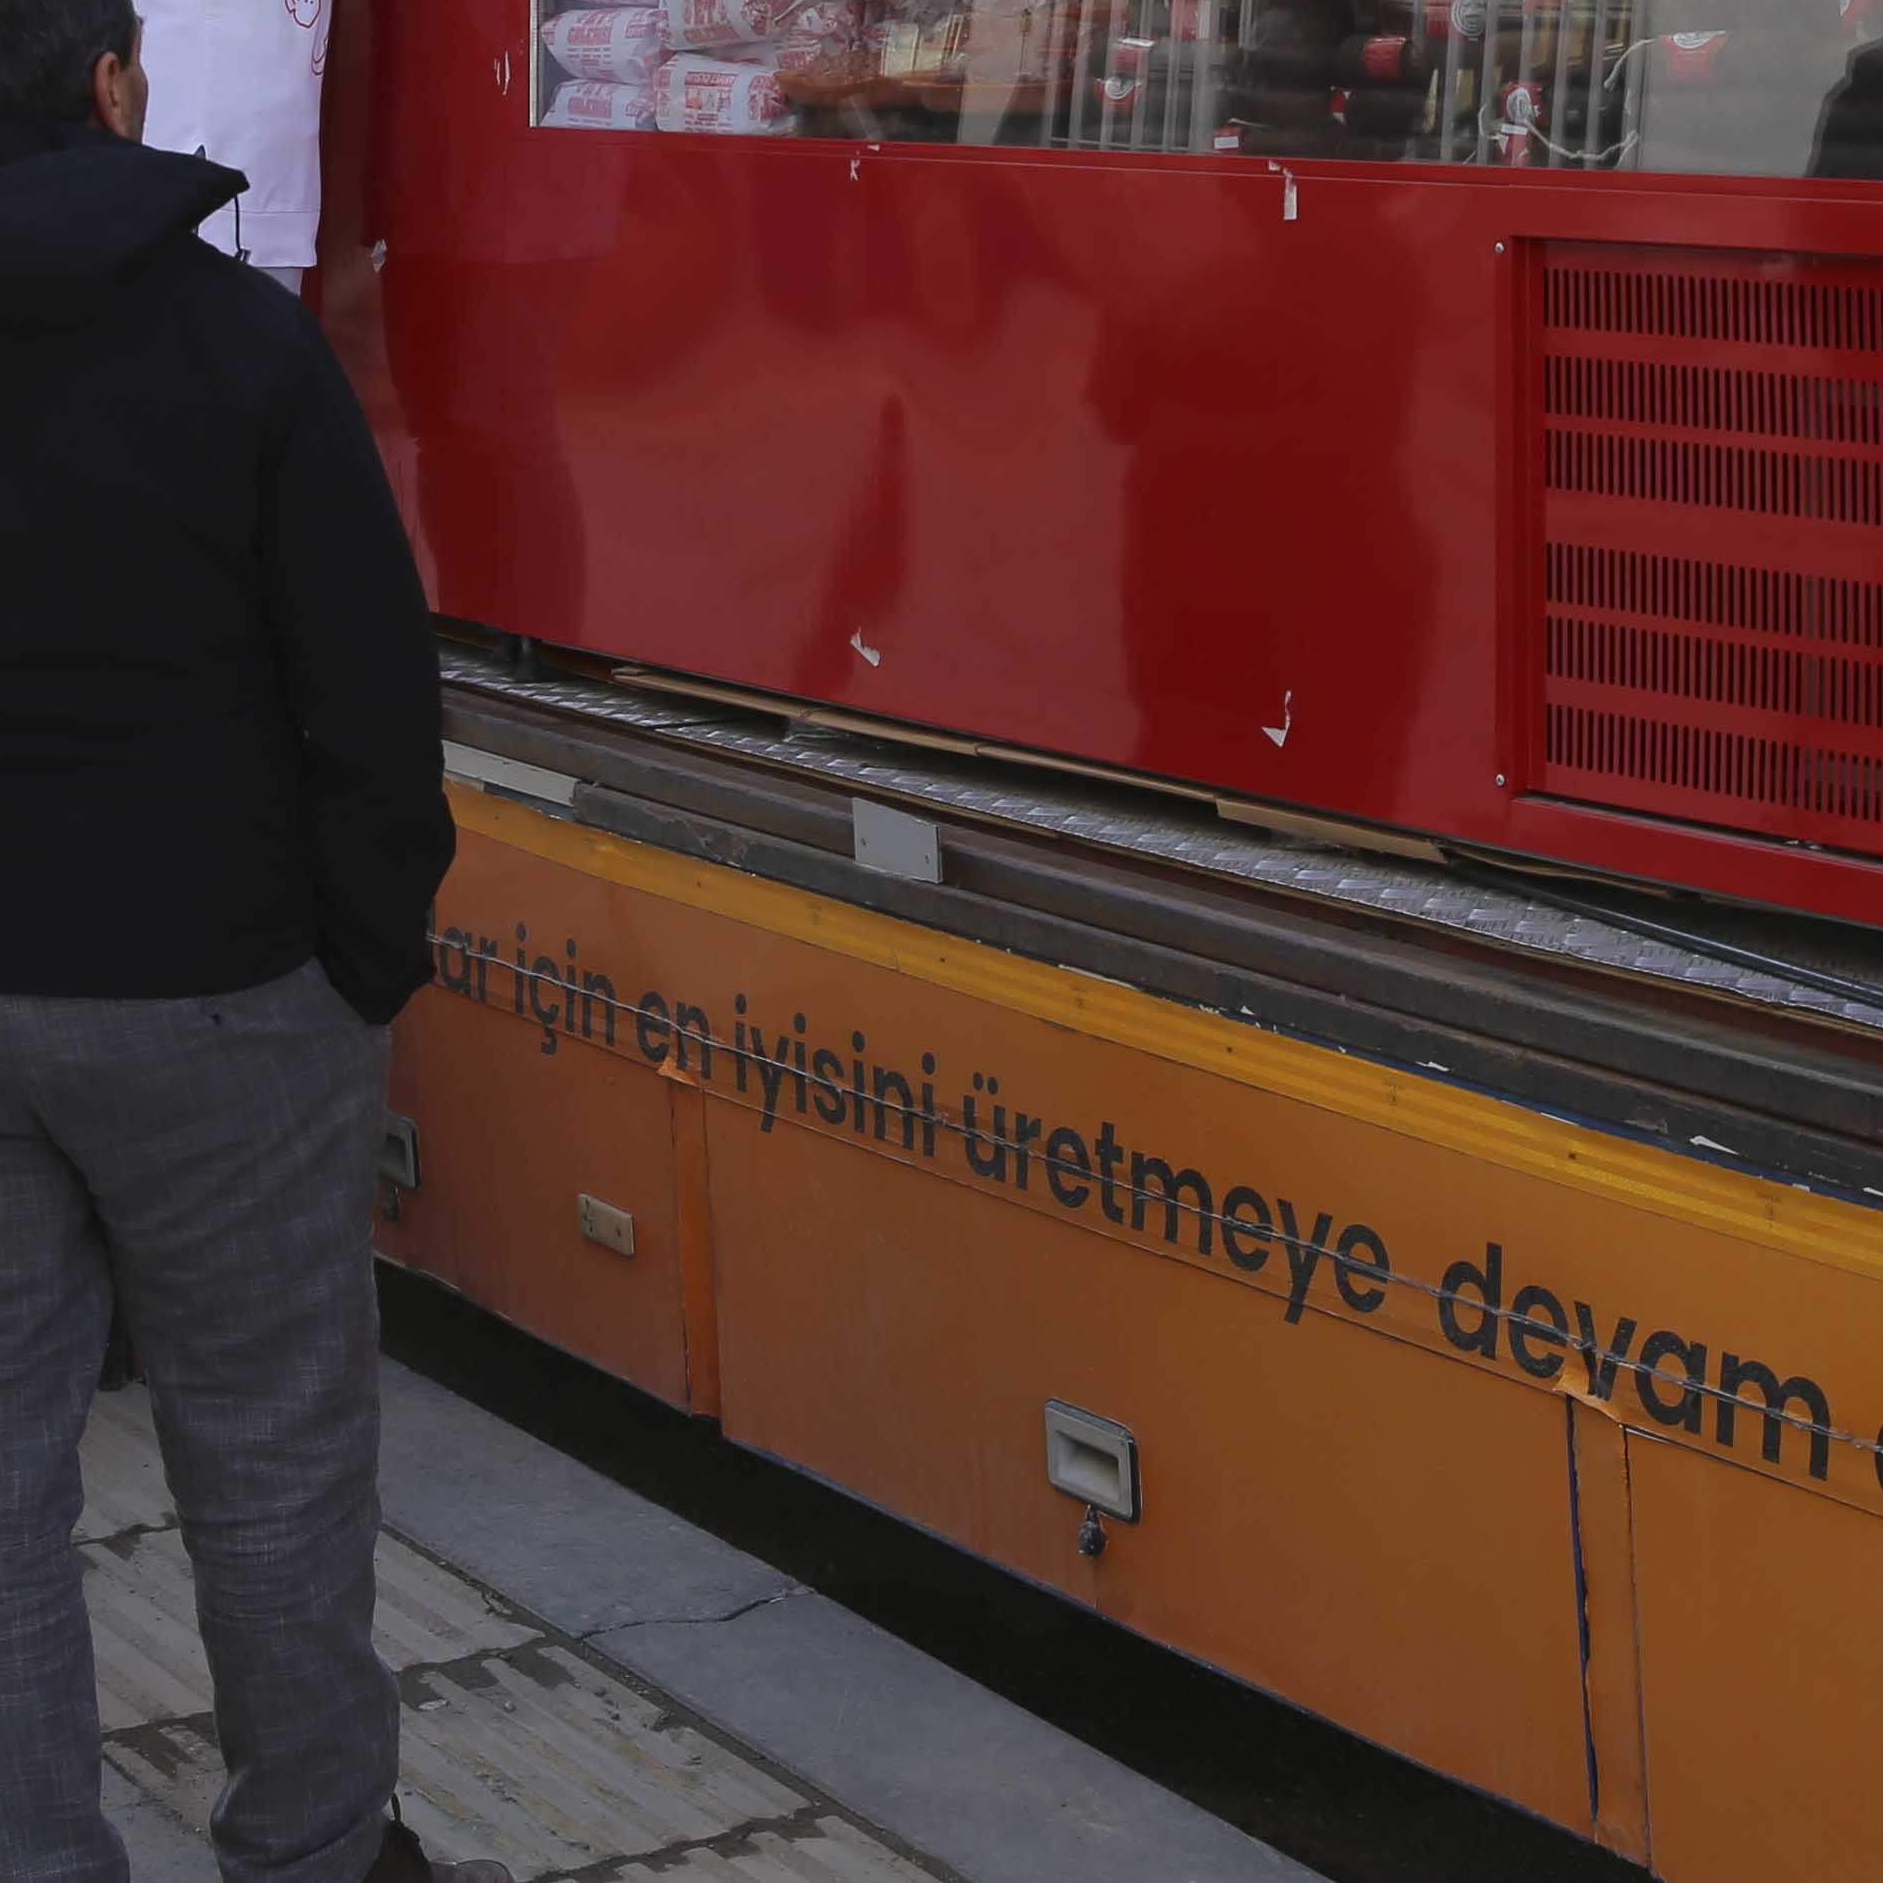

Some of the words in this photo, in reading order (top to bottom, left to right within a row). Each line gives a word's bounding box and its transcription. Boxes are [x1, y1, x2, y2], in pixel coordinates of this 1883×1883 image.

[435, 924, 498, 1004] ar
[515, 921, 616, 1055] için
[635, 985, 715, 1079] en
[734, 992, 937, 1158] iyisini
[963, 1069, 1390, 1324] üretmeye
[1437, 1241, 1829, 1481] devam
